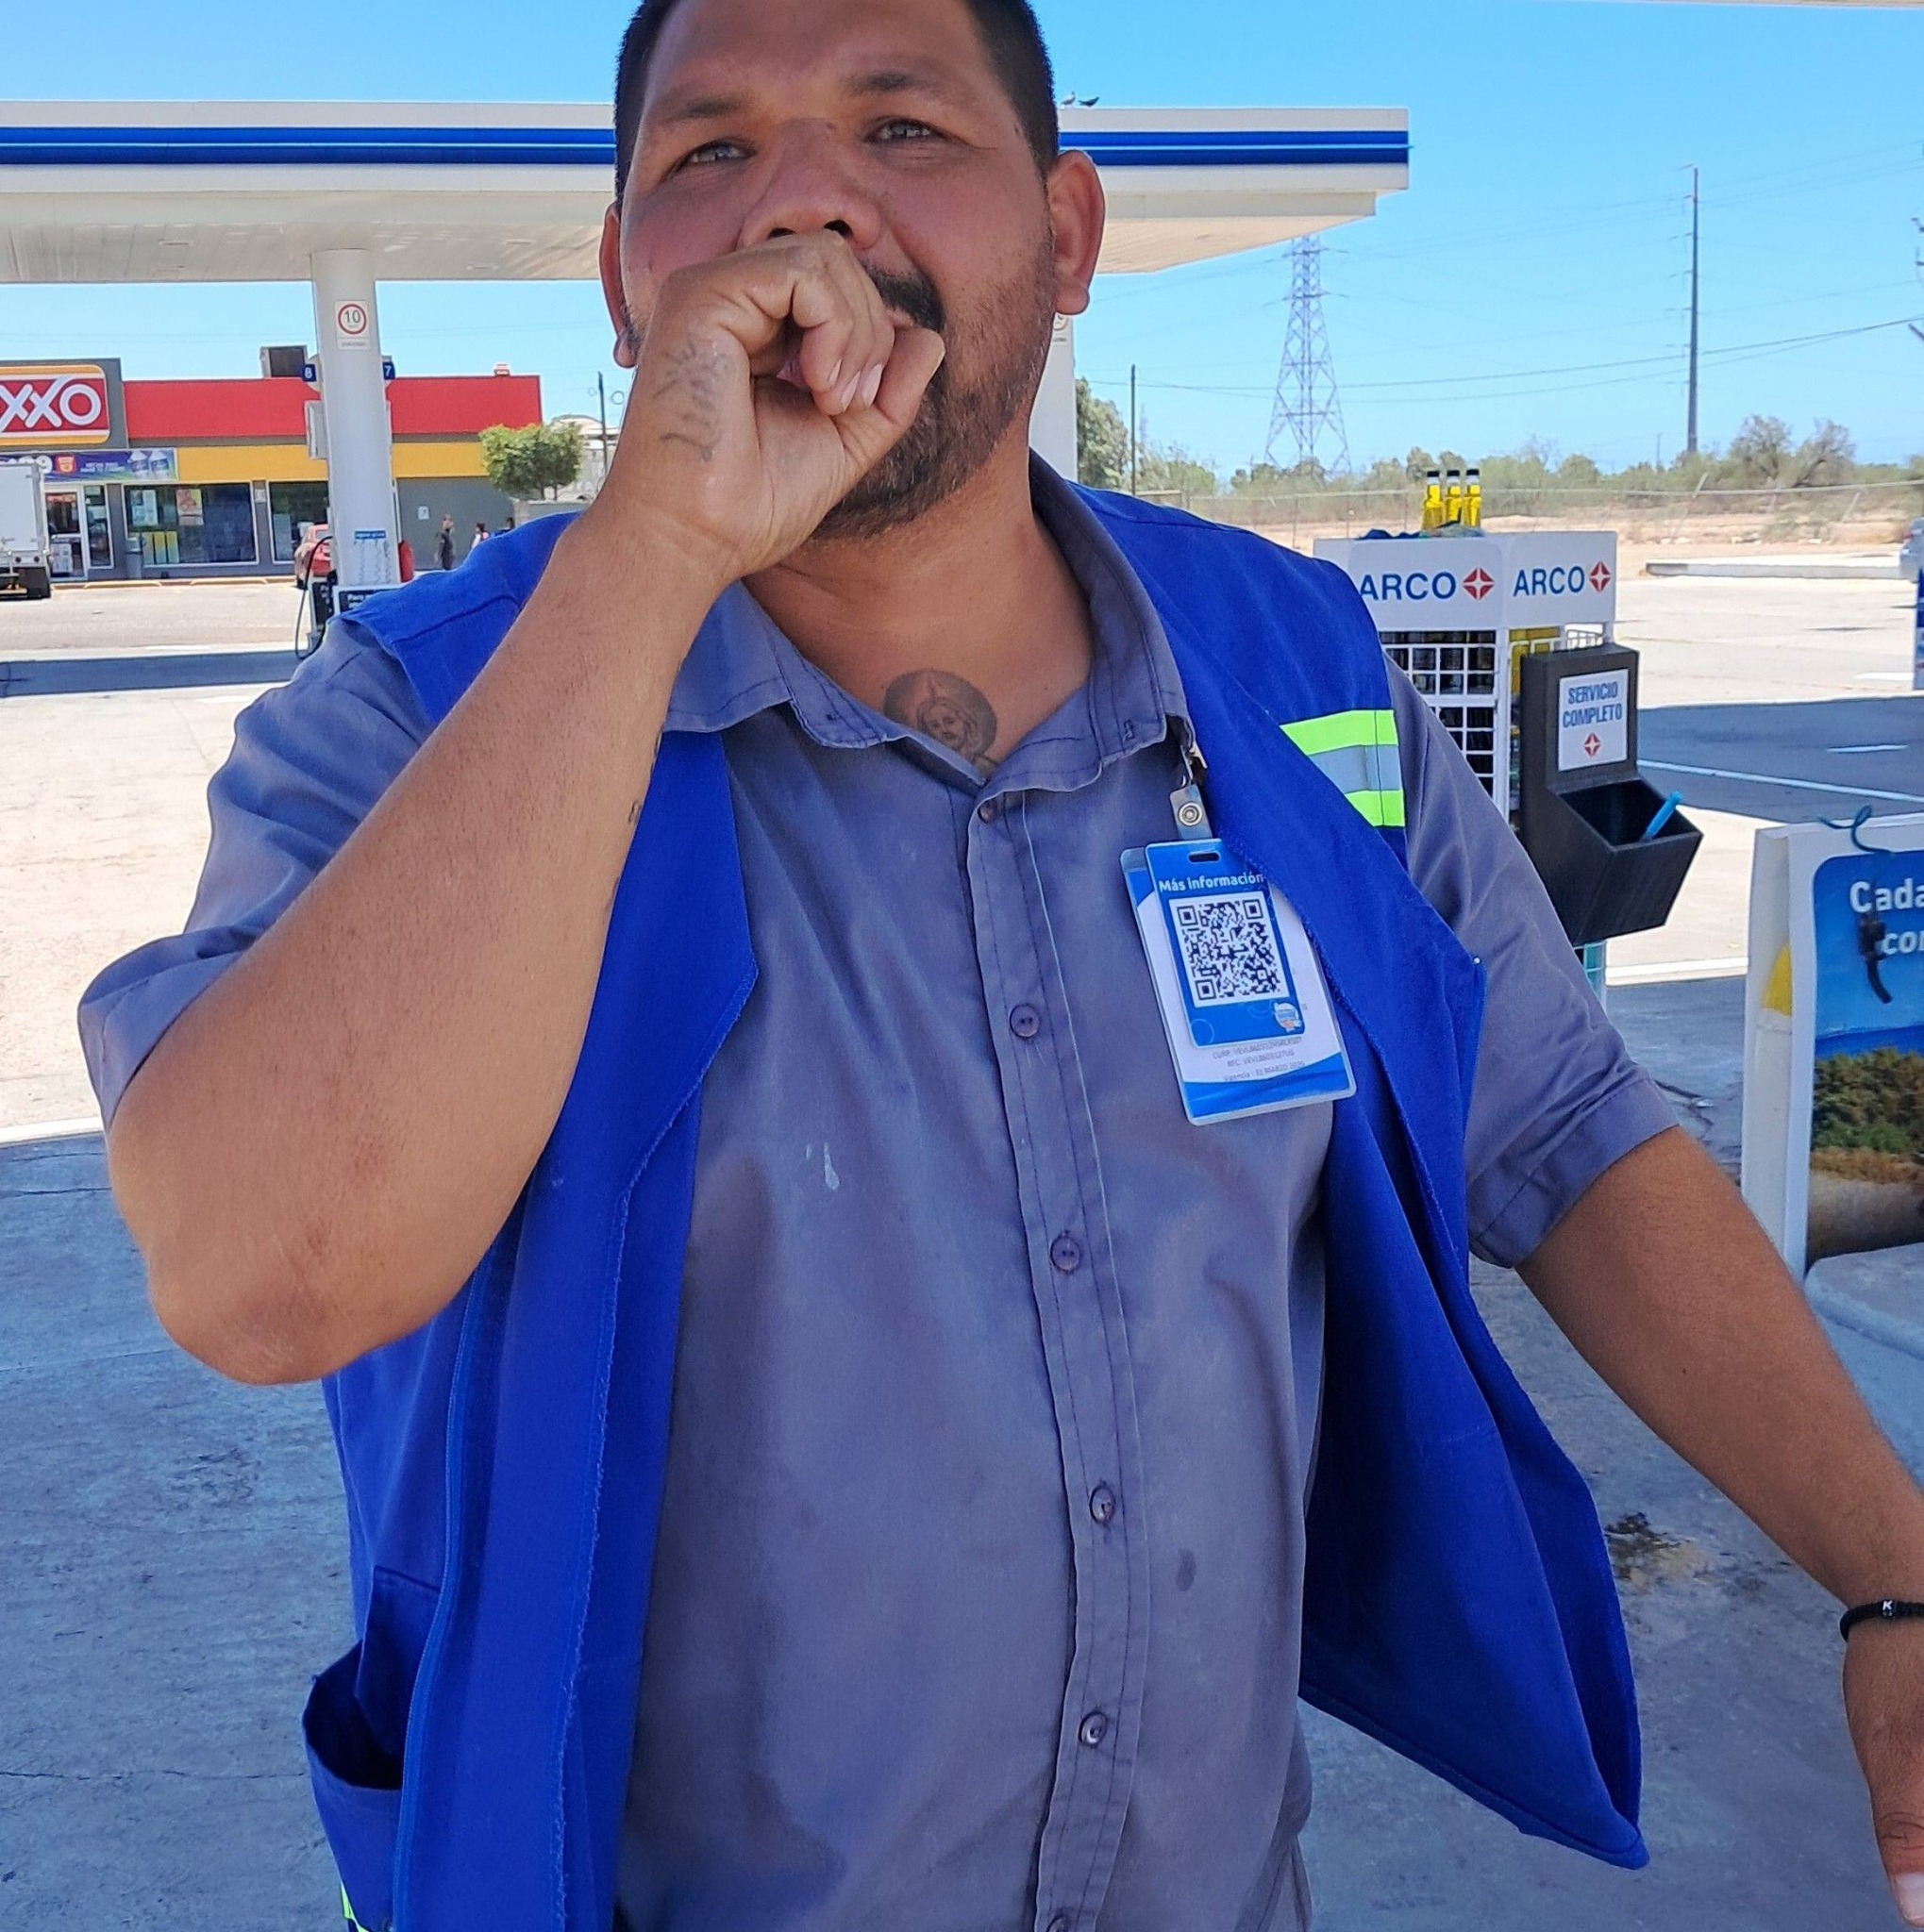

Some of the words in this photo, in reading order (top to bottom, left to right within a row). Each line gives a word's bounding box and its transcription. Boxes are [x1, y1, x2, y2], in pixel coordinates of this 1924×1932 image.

[343, 308, 361, 324] 10
[304, 366, 312, 379] 8
[384, 364, 393, 377] 7
[1359, 571, 1457, 601] ARCO
[1513, 565, 1585, 597] ARCO
[1567, 681, 1618, 705] SERVICIO
[1562, 703, 1623, 728] COMPLETO
[1158, 877, 1186, 892] Más
[1882, 1599, 1893, 1611] K
